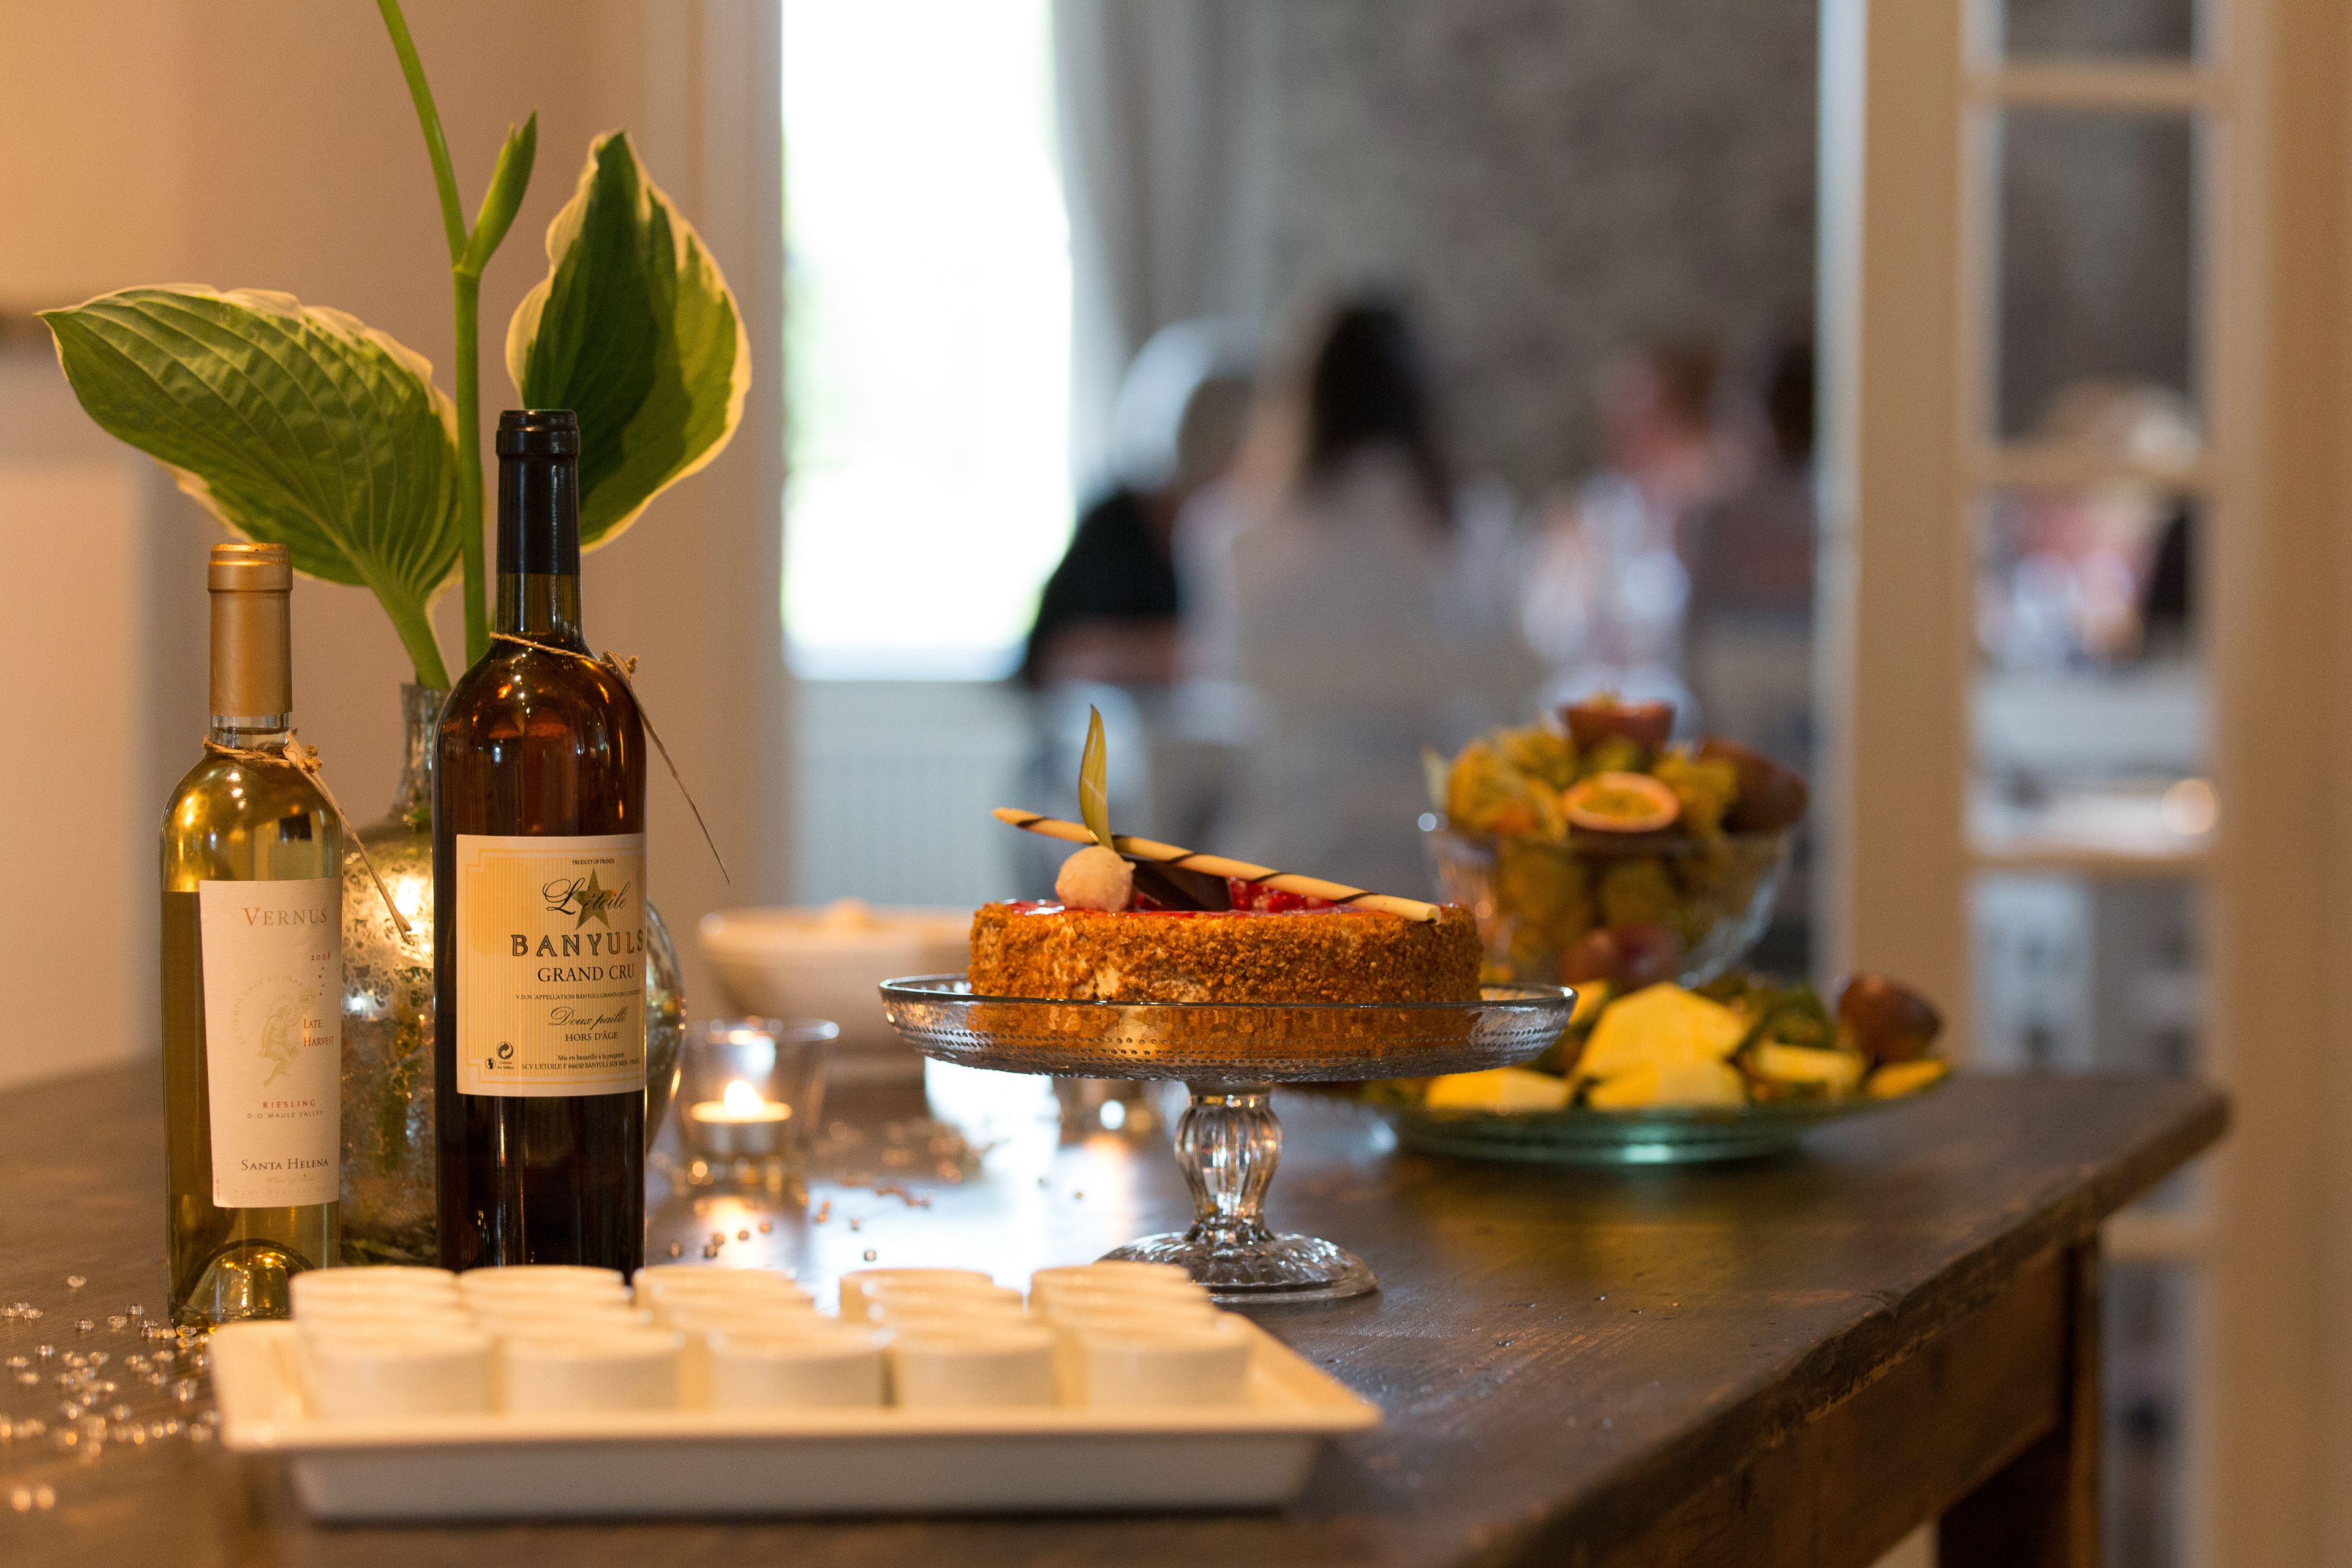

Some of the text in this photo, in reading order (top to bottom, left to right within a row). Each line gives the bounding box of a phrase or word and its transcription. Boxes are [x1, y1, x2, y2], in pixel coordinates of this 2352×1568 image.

[241, 908, 326, 926] VERNUS
[511, 929, 643, 957] BANYULS
[311, 951, 331, 960] 2008
[538, 963, 634, 982] GRAND CRU
[549, 1006, 592, 1026] Doux
[566, 1030, 618, 1041] HORS D'ÂGE
[263, 1099, 315, 1108] RIESLING
[241, 1158, 328, 1170] SANTA HELENA
